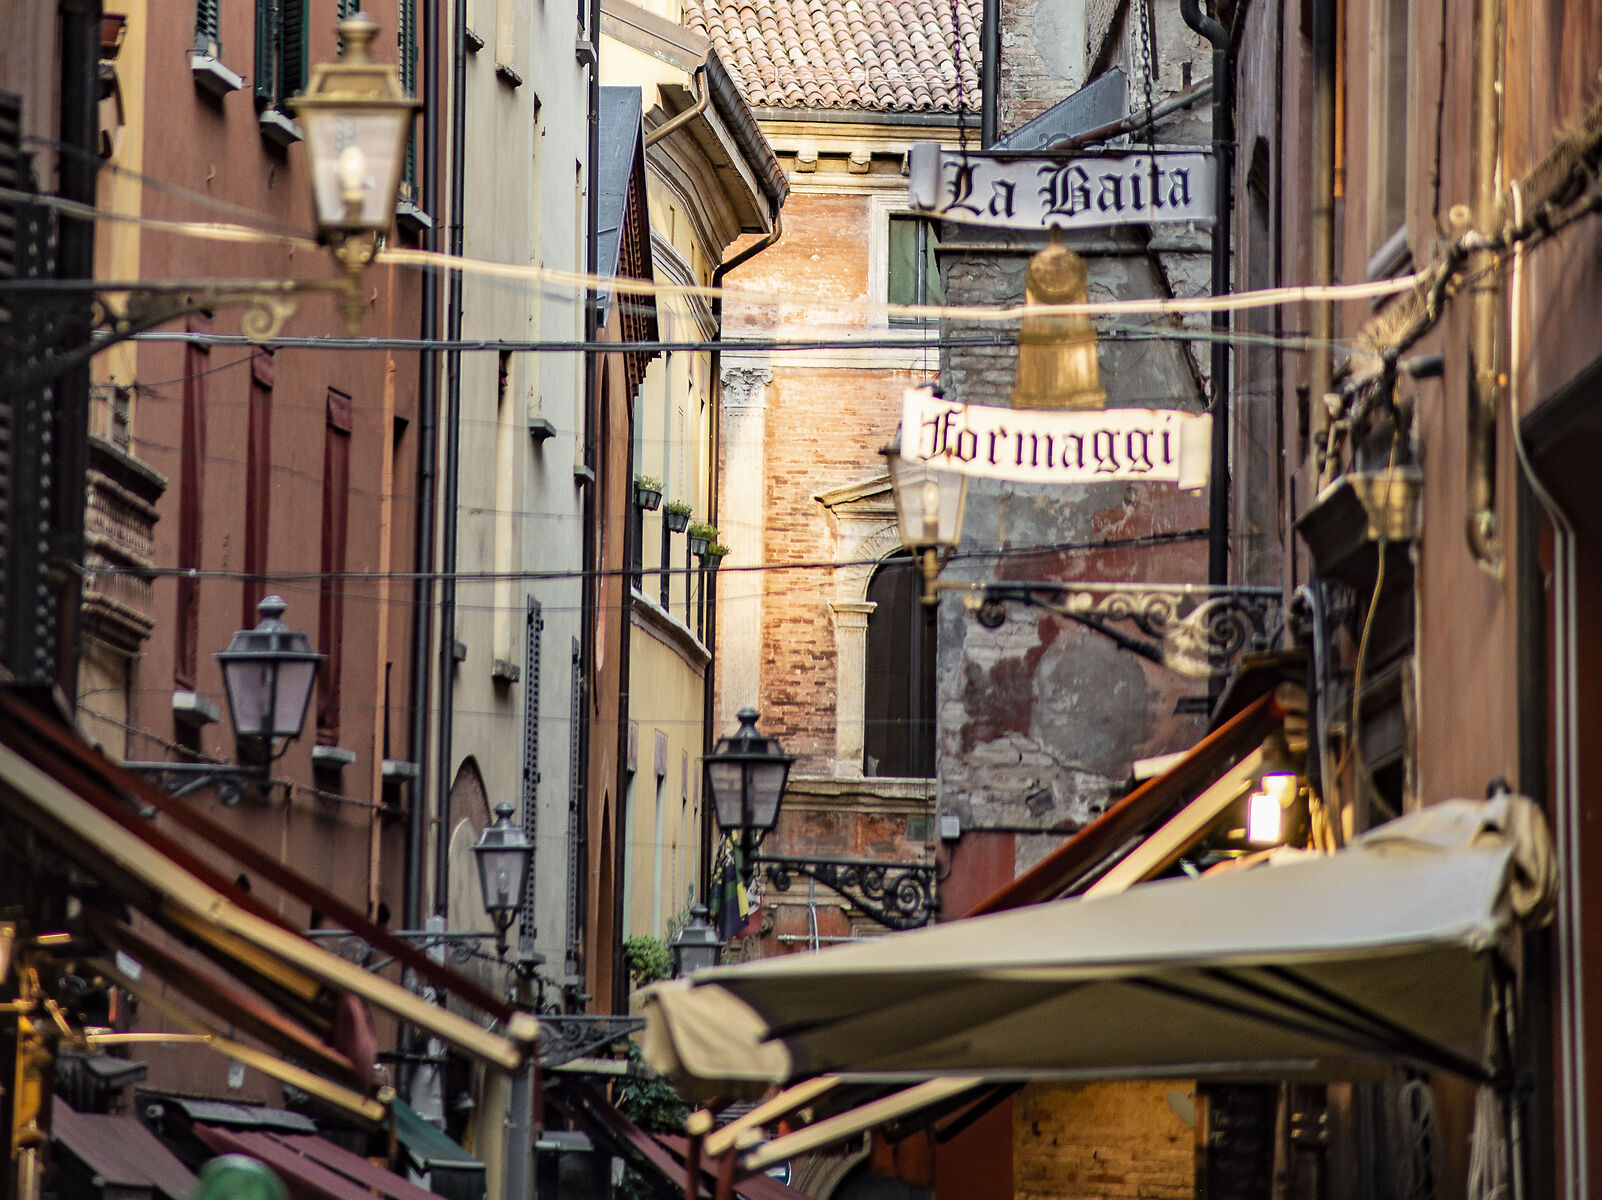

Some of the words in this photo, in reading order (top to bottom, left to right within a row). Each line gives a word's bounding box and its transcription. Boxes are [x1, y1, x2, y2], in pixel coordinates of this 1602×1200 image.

[943, 161, 1016, 217] La
[1037, 159, 1192, 225] Baita
[919, 409, 1173, 473] Formaggi
